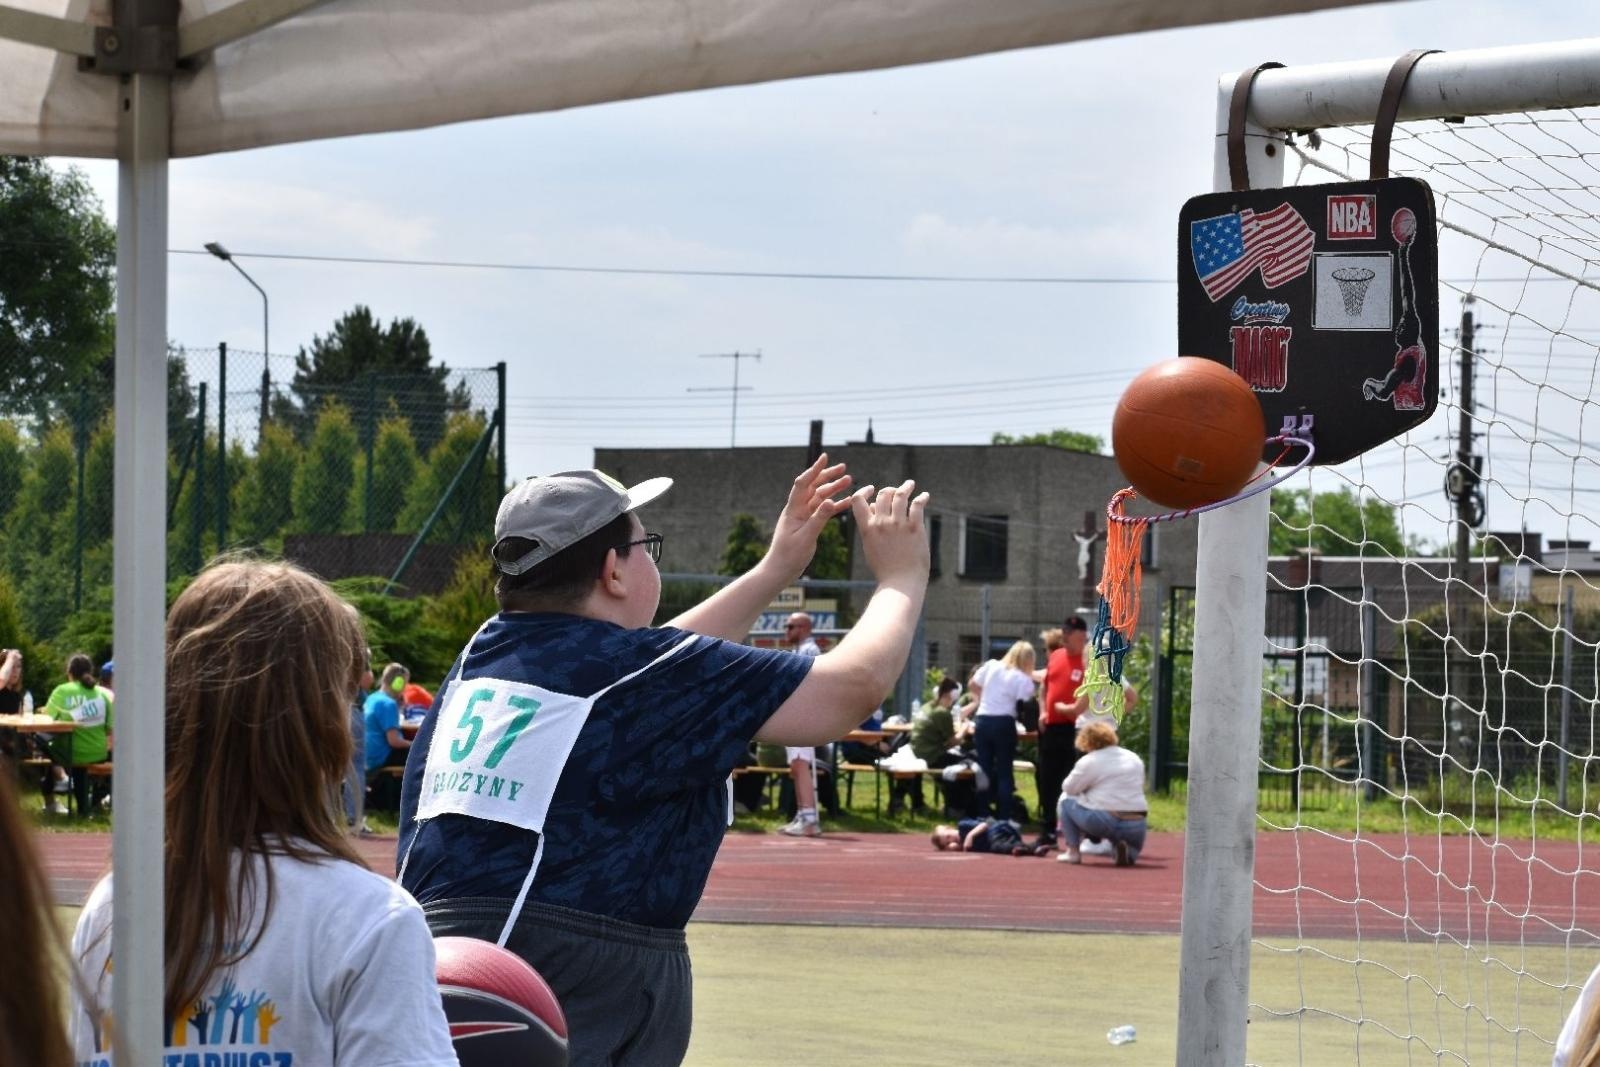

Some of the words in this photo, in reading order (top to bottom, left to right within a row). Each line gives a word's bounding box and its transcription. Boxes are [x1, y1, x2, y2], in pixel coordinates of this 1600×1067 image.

[1331, 201, 1373, 233] NBA
[1229, 325, 1292, 393] MAGIC
[450, 687, 542, 770] 57
